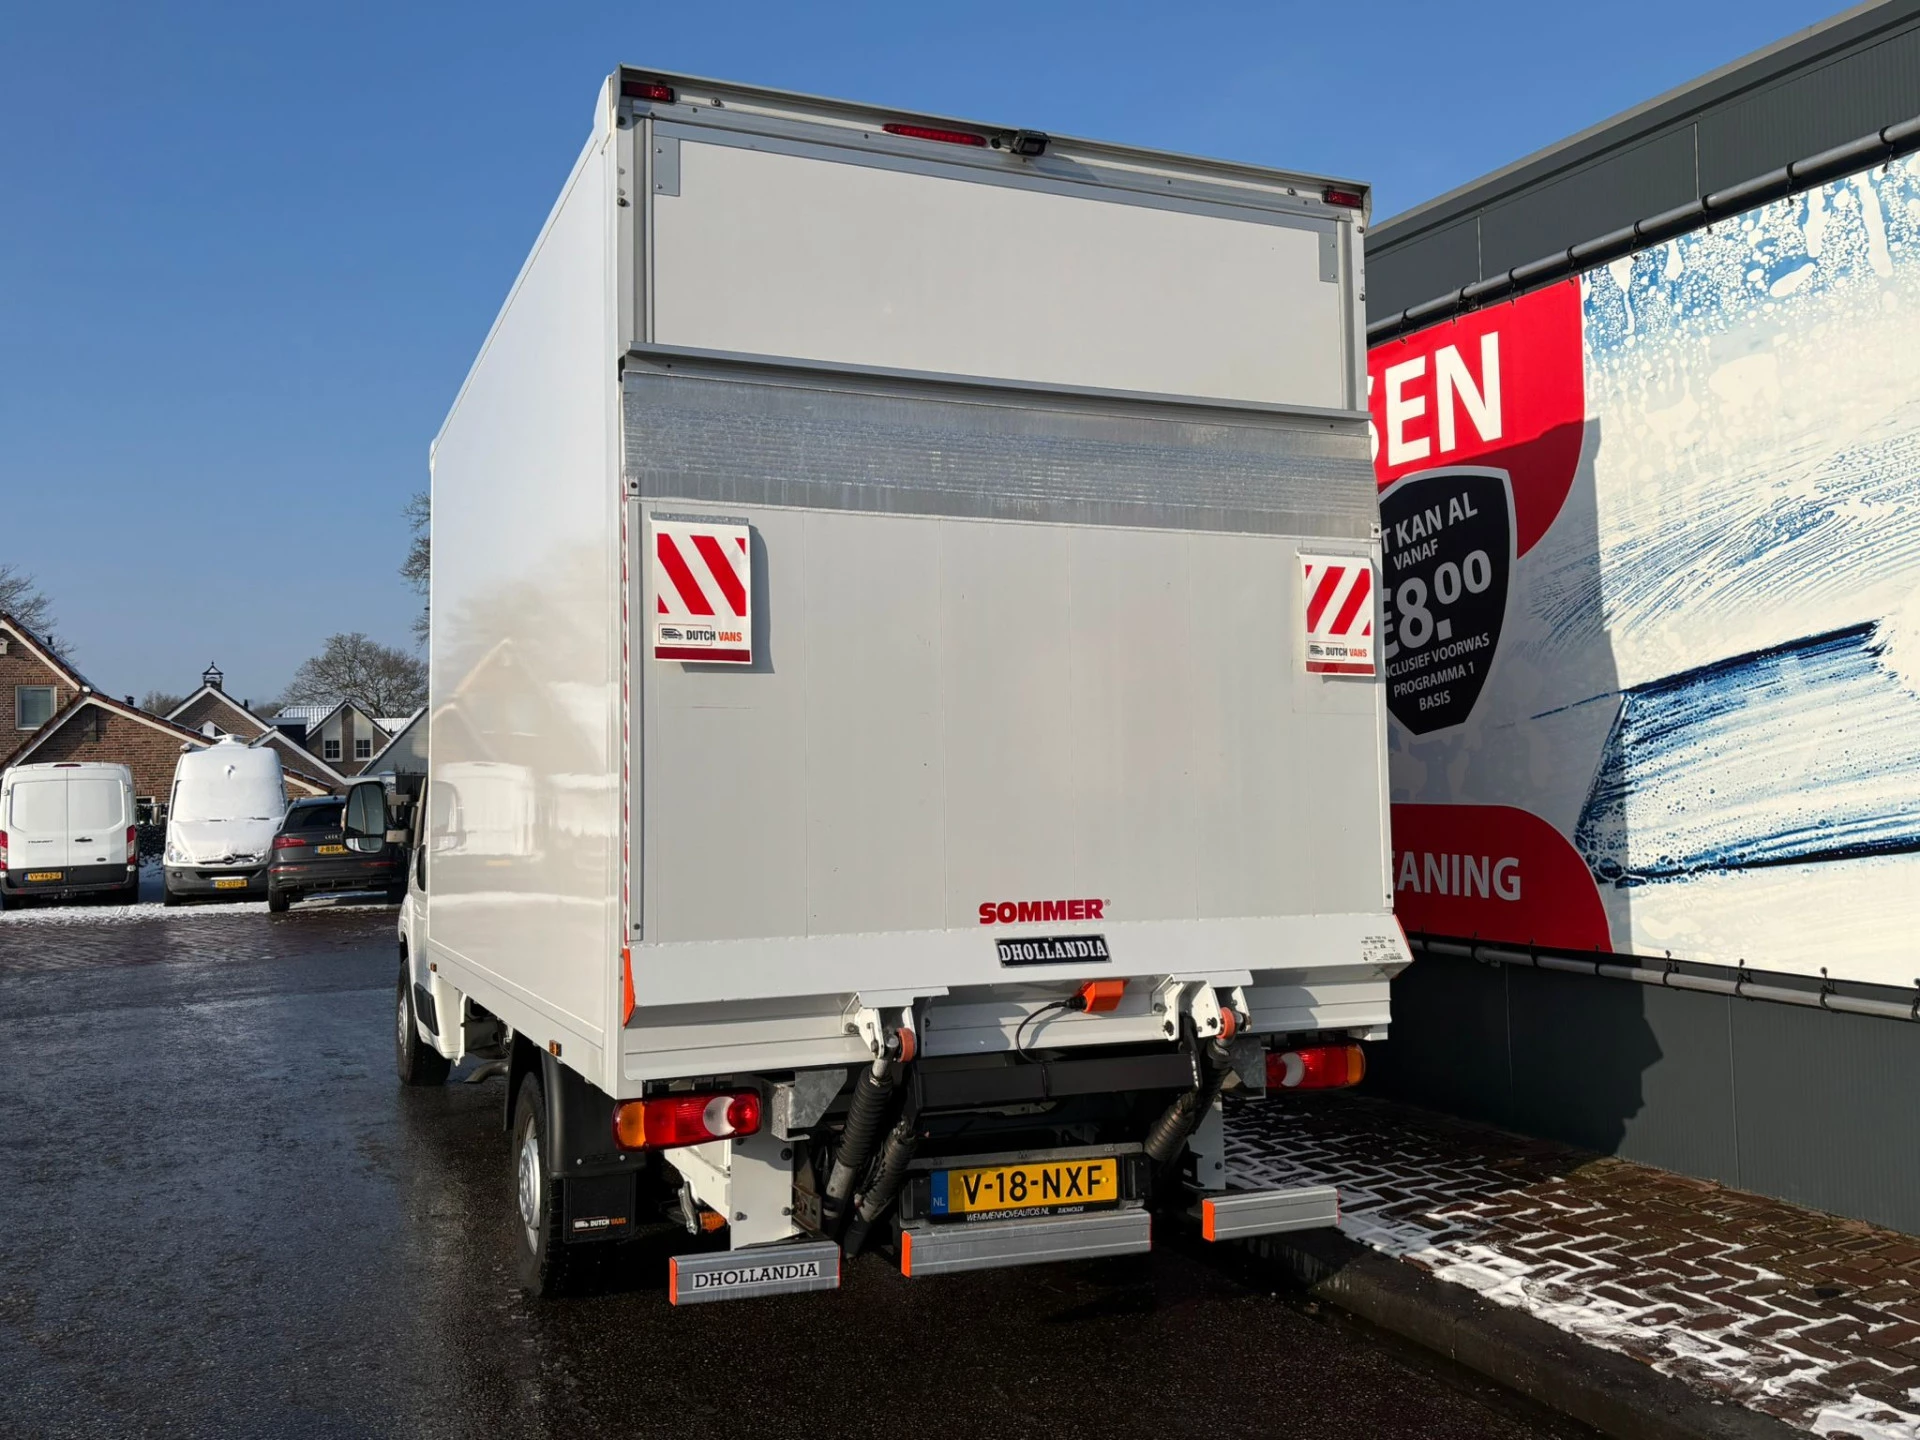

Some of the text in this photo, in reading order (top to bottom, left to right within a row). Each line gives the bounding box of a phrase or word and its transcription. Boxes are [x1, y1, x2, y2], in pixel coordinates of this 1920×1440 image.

[1395, 504, 1443, 548] KAN
[1448, 492, 1478, 526] AL
[1393, 538, 1439, 571] VANAF
[686, 629, 742, 642] DUTCH VANS
[1431, 632, 1490, 663] VOORWAS
[1325, 646, 1367, 657] DUTCH VANS
[1393, 661, 1475, 698] PROGRAMMA 1
[1419, 689, 1450, 712] BASIS
[1392, 851, 1521, 901] ANING
[998, 940, 1108, 961] DHOLLANDIA
[933, 1165, 1102, 1207] NL V-18-NXF
[590, 1217, 627, 1227] DUTCH VANS
[694, 1263, 818, 1289] DHOLLANDIA
